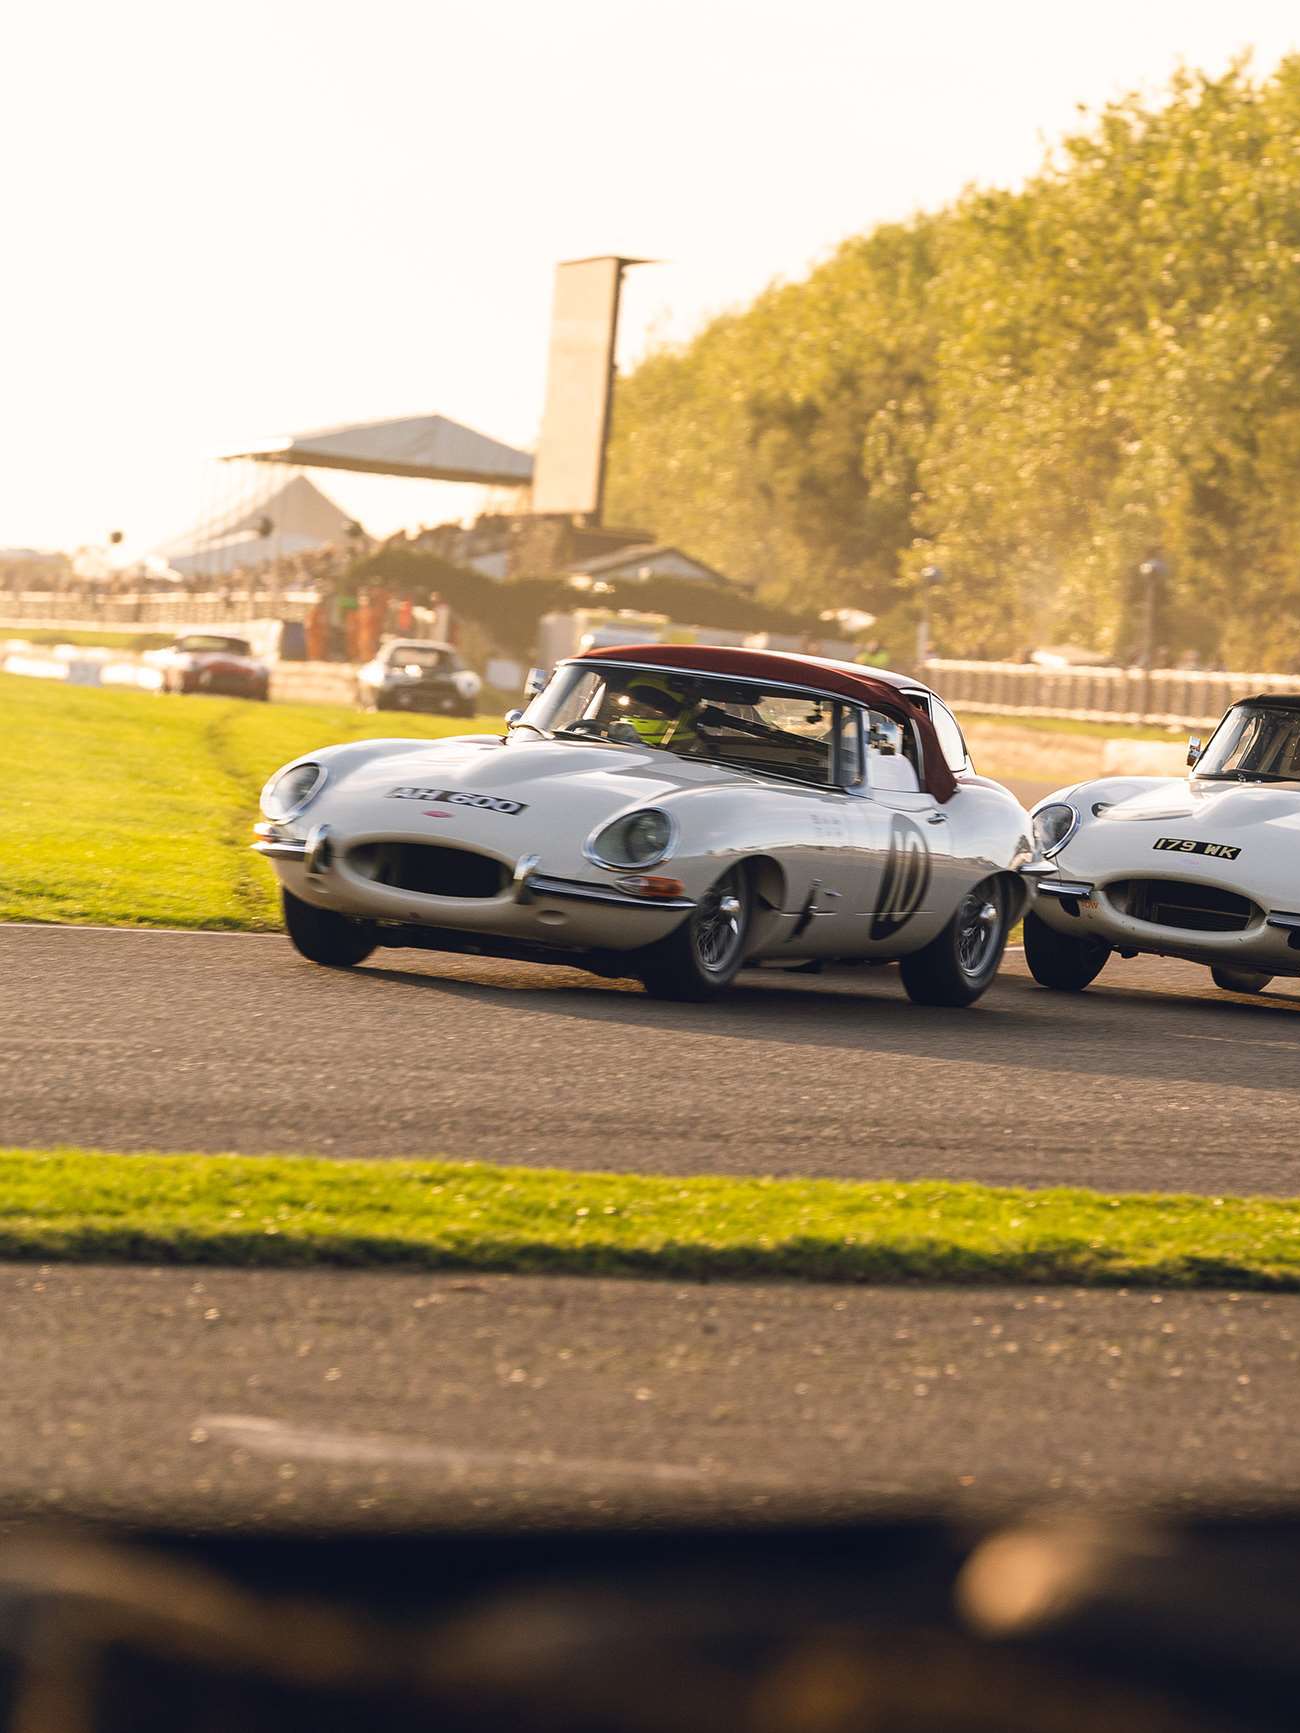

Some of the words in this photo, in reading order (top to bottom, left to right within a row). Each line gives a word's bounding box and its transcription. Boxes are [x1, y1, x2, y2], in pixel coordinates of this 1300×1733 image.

[448, 793, 521, 813] 600
[1156, 839, 1197, 852] 179
[1204, 844, 1237, 859] WK
[876, 830, 927, 922] 10
